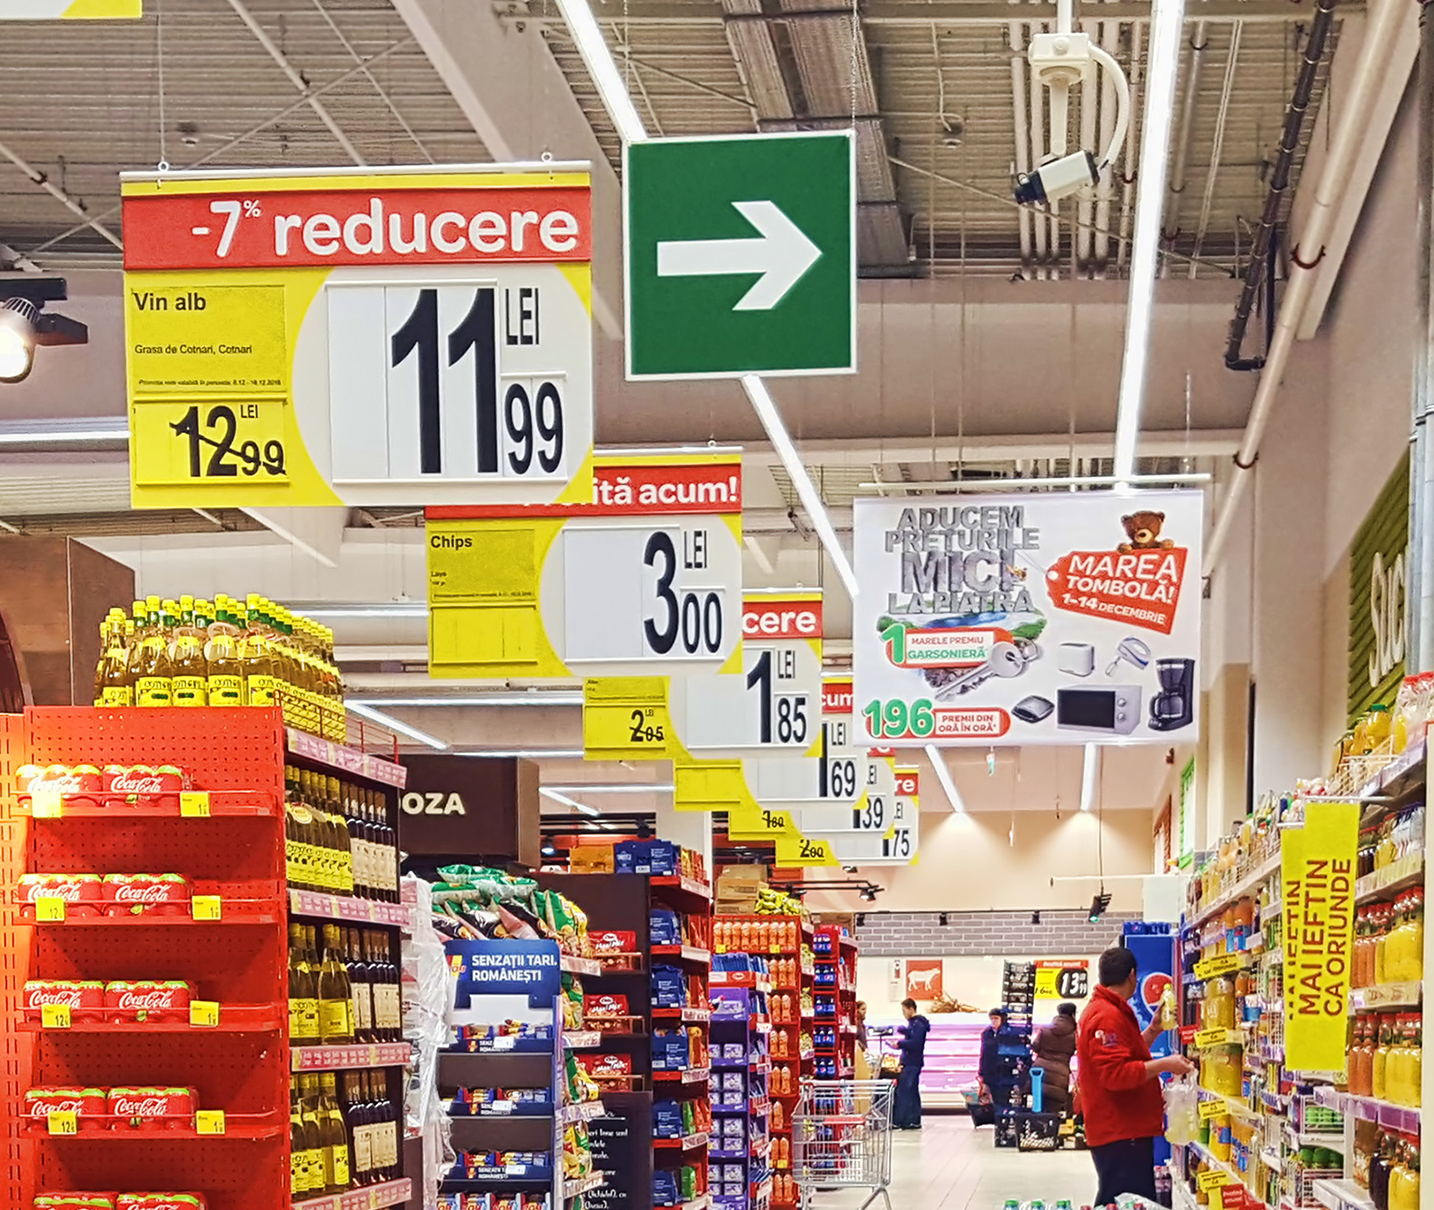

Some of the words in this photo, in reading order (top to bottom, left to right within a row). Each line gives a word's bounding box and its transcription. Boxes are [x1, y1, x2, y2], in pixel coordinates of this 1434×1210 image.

[273, 198, 578, 256] reducere
[133, 293, 167, 310] Vin
[175, 293, 206, 310] alb
[505, 288, 541, 345] LEI
[135, 345, 163, 354] Grasa
[165, 345, 176, 354] de
[390, 289, 498, 475] 11
[240, 404, 258, 418] LEI
[169, 405, 237, 478] 12
[503, 382, 565, 475] 99
[240, 439, 286, 476] 99
[639, 476, 738, 504] acum!
[897, 506, 1024, 530] ADUCEM
[431, 534, 473, 550] Chips
[684, 531, 708, 569] LEI
[902, 550, 1015, 593] MICI
[1068, 554, 1178, 582] MAREA
[643, 531, 678, 654] 3
[888, 592, 923, 614] LA
[1066, 575, 1175, 604] TOMBOLĂ!
[682, 592, 722, 654] 00
[1061, 593, 1097, 609] 1-14
[1098, 602, 1166, 625] DECEMBRIE
[882, 624, 905, 663] 1
[778, 650, 796, 679] LEI
[747, 651, 771, 743] 1
[778, 697, 806, 743] 85
[831, 723, 846, 746] LEI
[864, 699, 934, 737] 196
[938, 722, 958, 733] ORĂ
[942, 714, 972, 724] PREMII
[975, 714, 993, 723] DIN
[831, 760, 856, 797] 69
[861, 796, 884, 829] 39
[894, 830, 910, 857] 75
[1302, 860, 1328, 955] IEFTIN
[1326, 859, 1351, 975] ORIUNDE
[472, 955, 524, 968] SENZAȚII
[527, 955, 557, 966] TARI.
[472, 968, 541, 983] ROMÂNEȘTI
[1060, 971, 1078, 995] 13
[1298, 964, 1322, 1015] MAI
[1324, 982, 1344, 1016] CA
